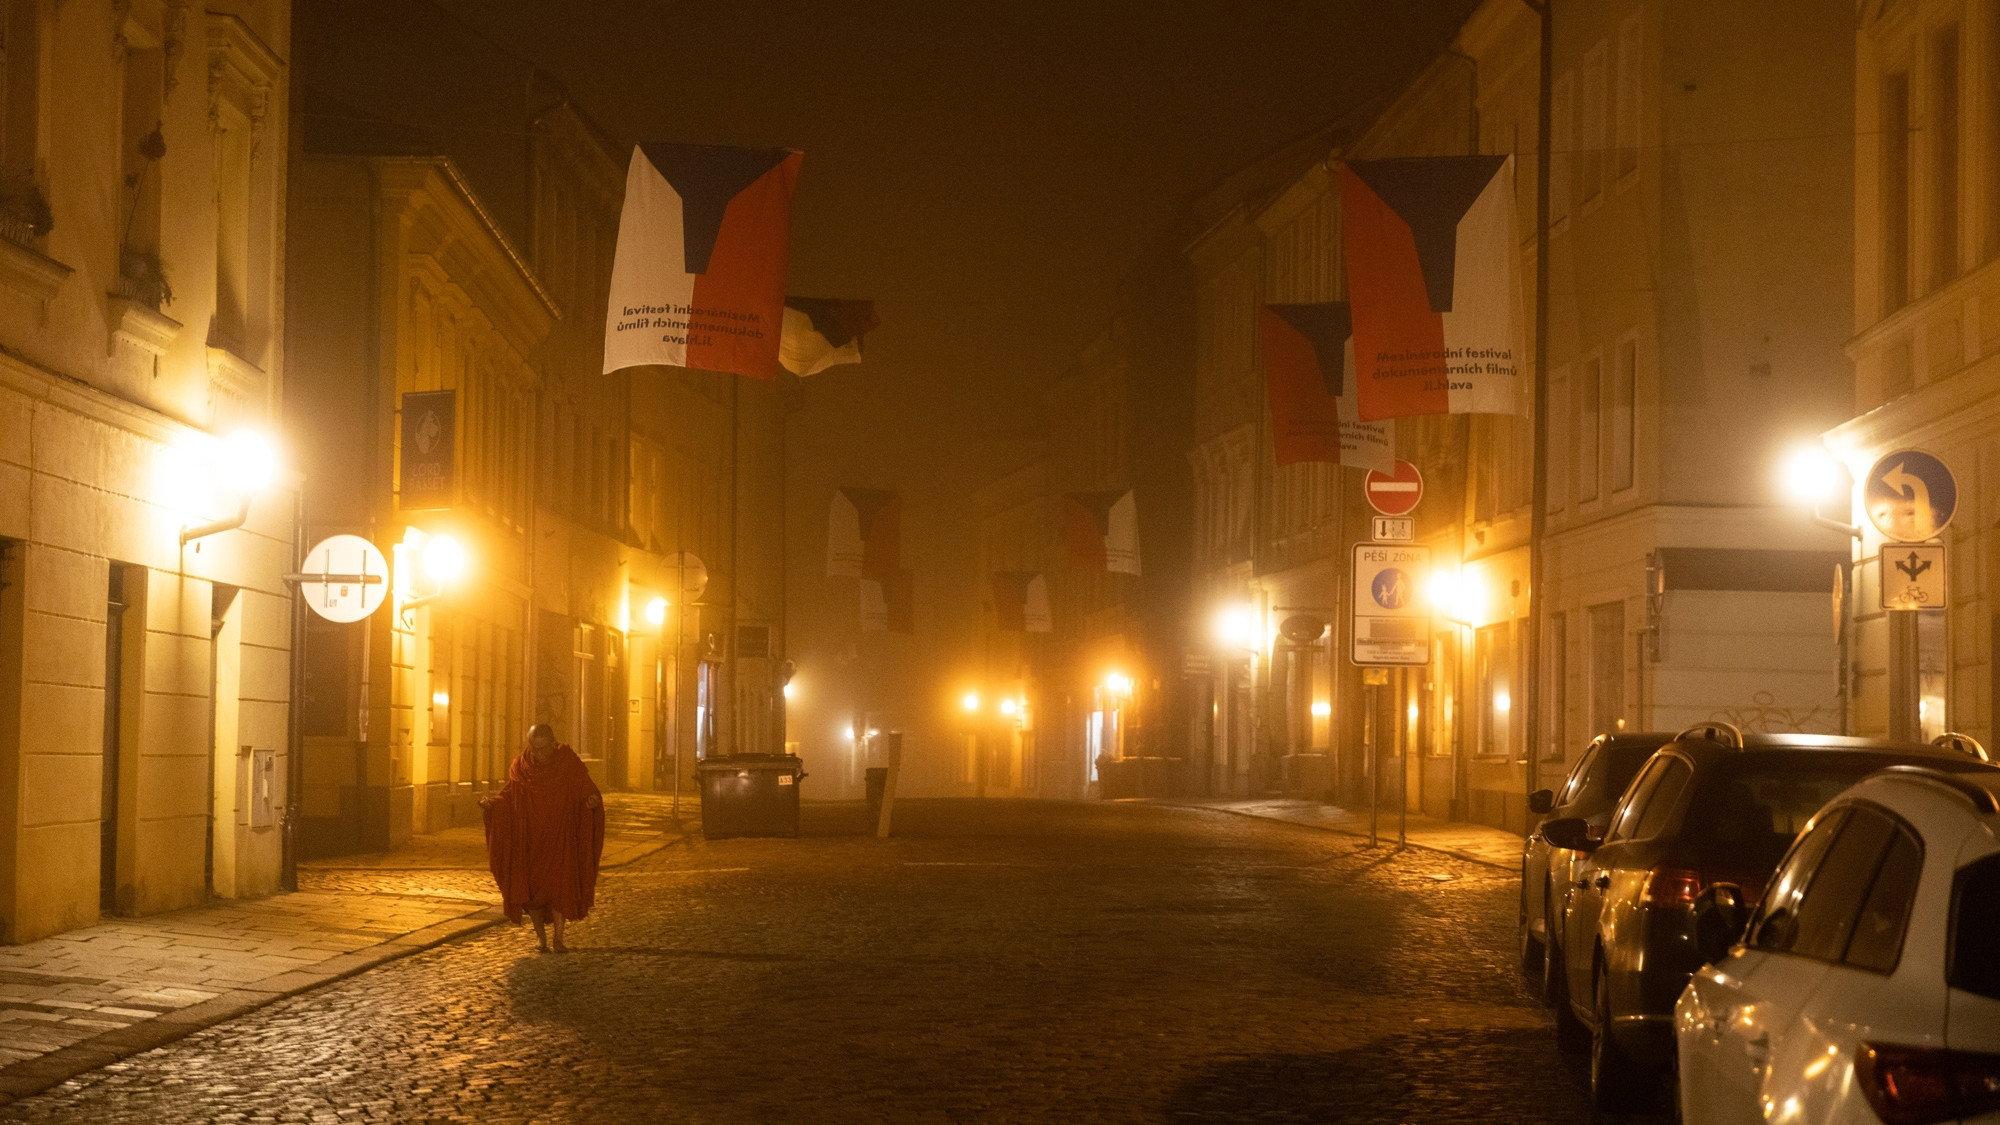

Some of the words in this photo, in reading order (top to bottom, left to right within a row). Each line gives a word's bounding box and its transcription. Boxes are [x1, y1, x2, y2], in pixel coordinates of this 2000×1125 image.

[1465, 347, 1512, 360] festival
[1486, 363, 1517, 376] filmů
[1352, 421, 1385, 435] festival
[1364, 549, 1388, 562] PĚŠÍ
